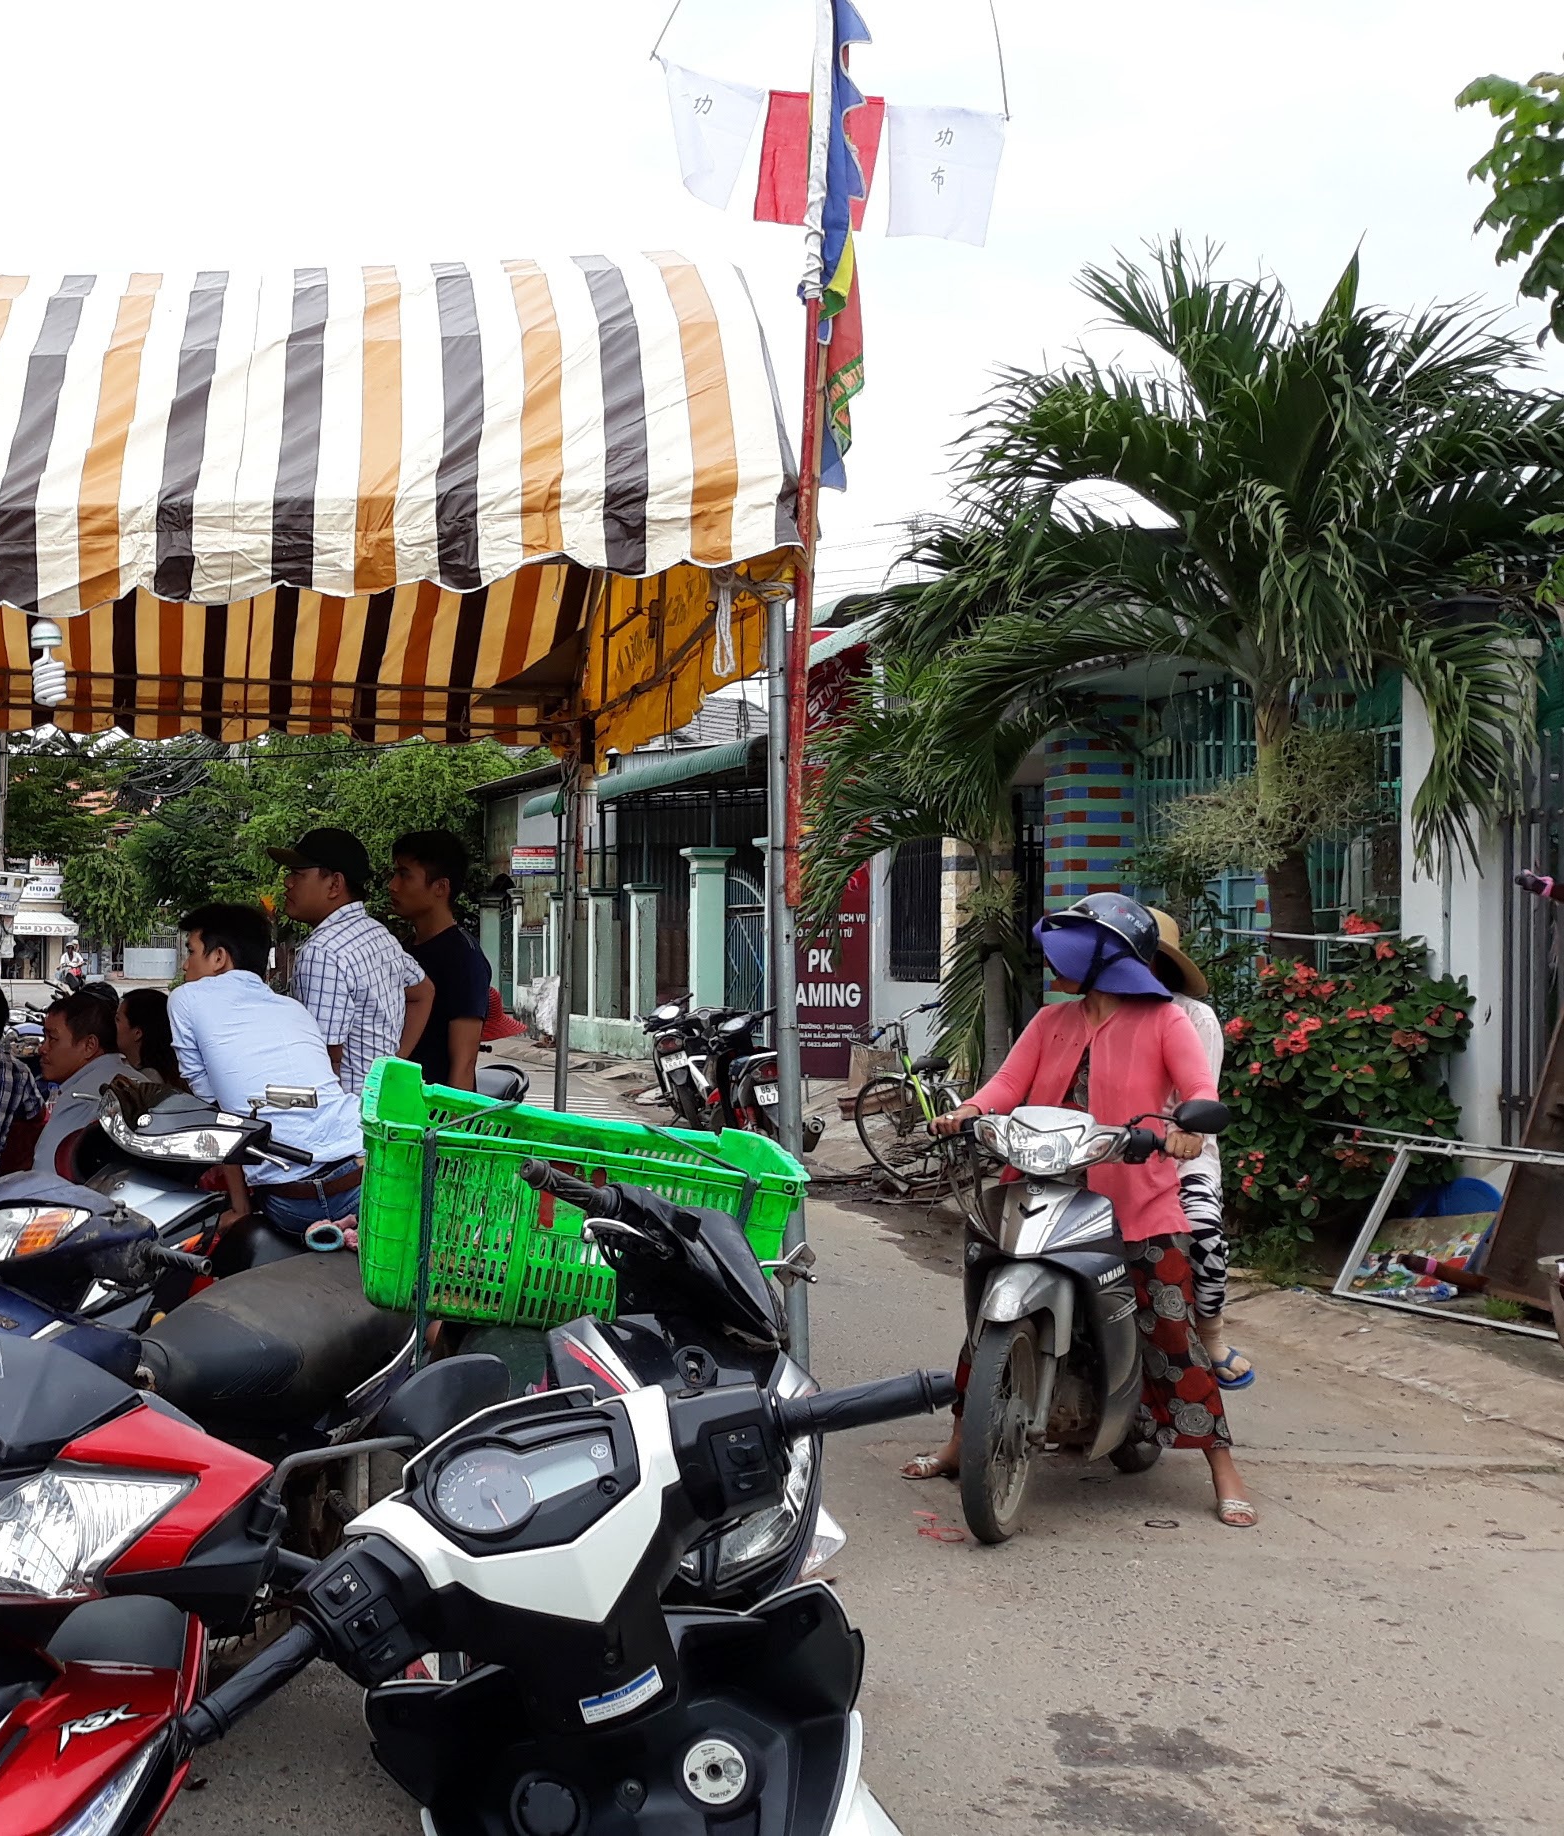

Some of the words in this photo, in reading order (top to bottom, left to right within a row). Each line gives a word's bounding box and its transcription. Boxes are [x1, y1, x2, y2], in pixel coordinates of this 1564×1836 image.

[807, 666, 851, 718] STING
[807, 948, 833, 973] PK
[795, 982, 862, 1008] AMING
[759, 1093, 777, 1103] 047
[1097, 1263, 1127, 1286] YAMAHA
